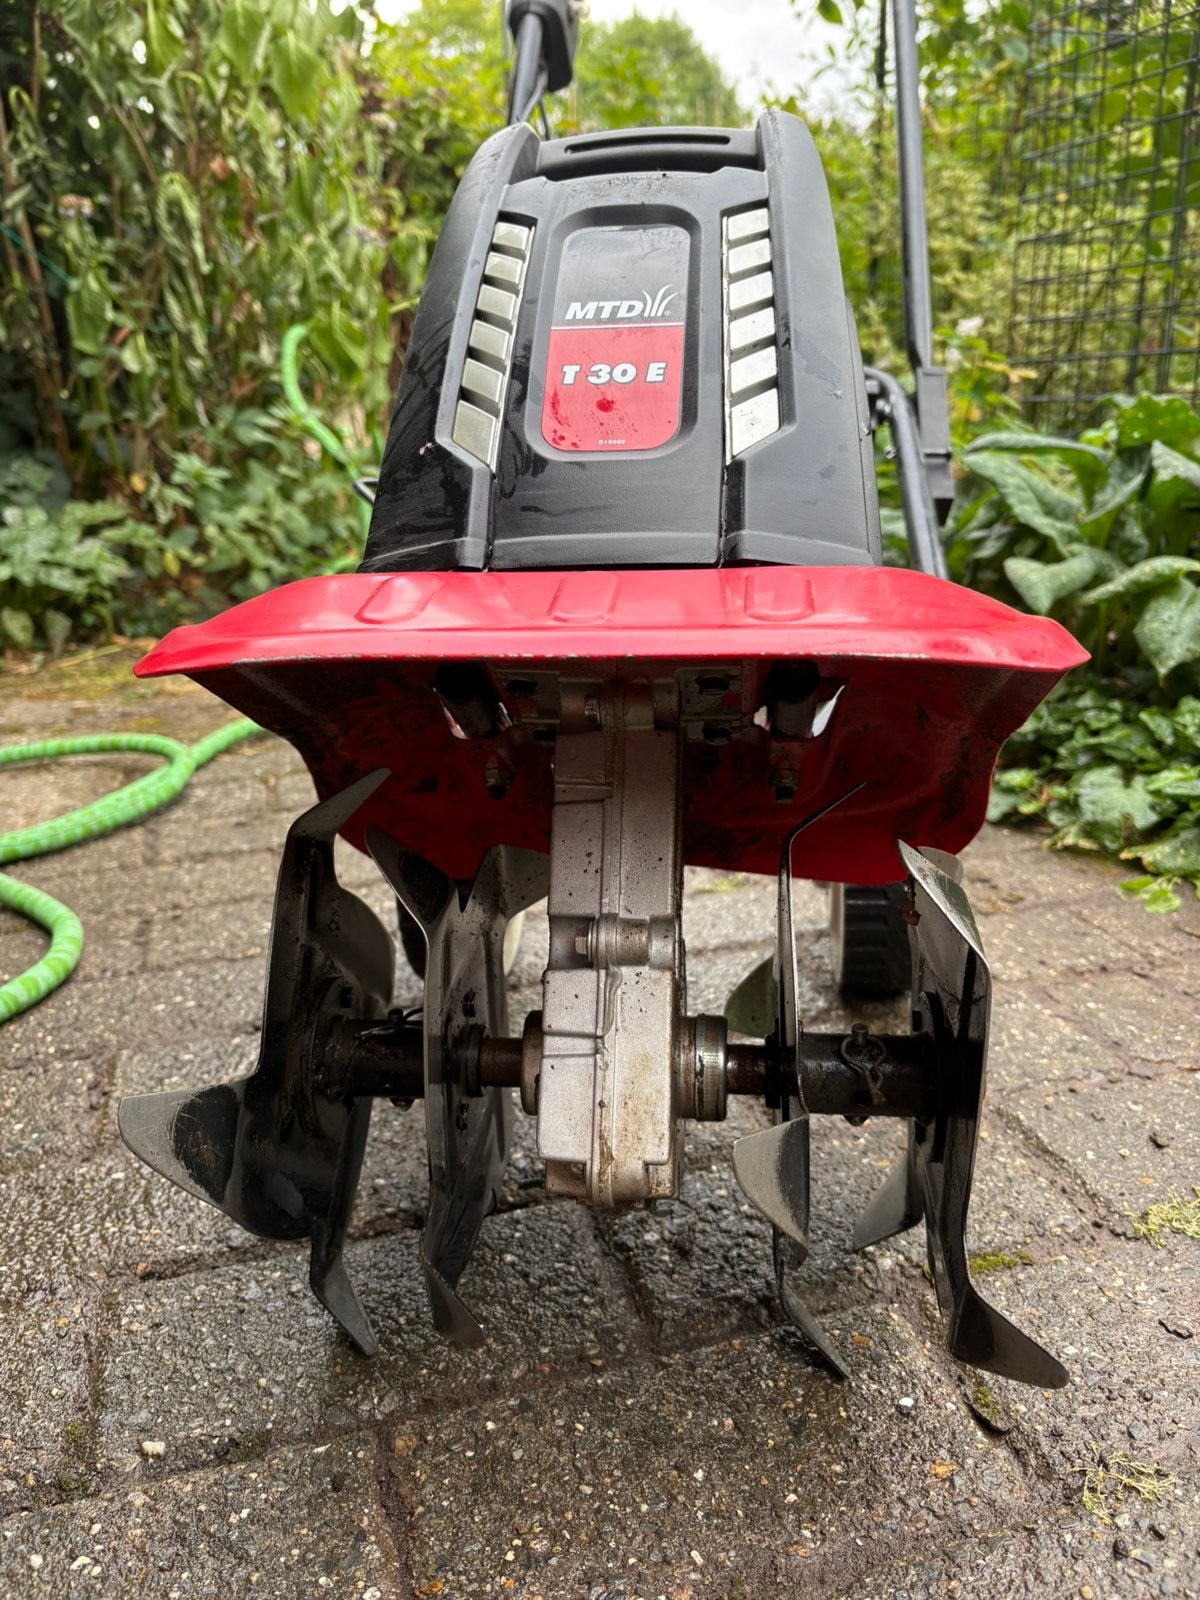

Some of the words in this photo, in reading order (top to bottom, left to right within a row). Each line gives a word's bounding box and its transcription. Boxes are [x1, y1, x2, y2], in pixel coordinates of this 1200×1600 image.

[565, 300, 643, 320] MTD
[562, 365, 581, 385] T
[586, 363, 637, 385] 30
[645, 361, 667, 383] E
